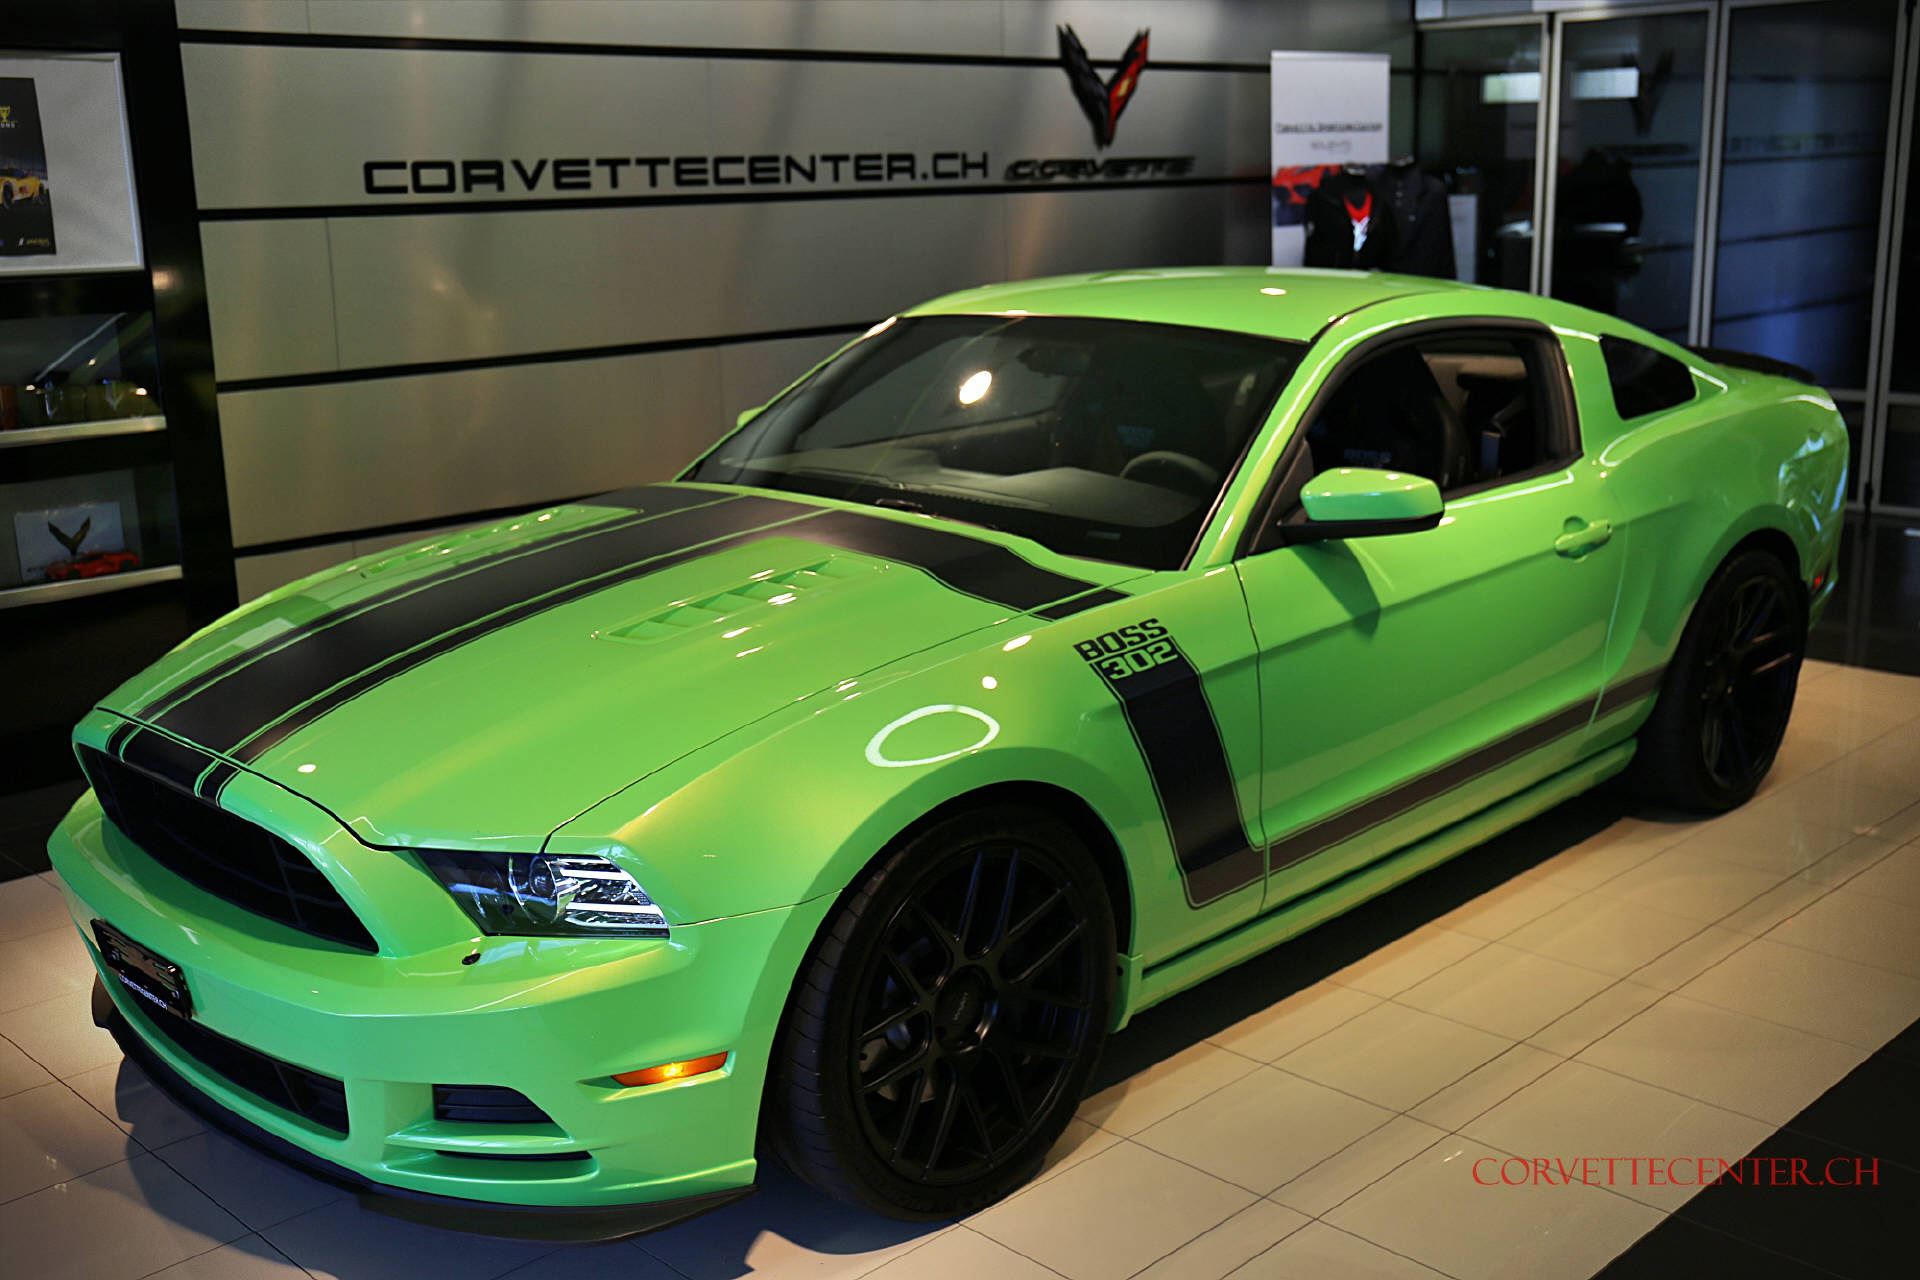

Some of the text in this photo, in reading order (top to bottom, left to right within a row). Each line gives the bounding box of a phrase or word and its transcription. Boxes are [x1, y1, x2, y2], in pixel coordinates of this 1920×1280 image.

[363, 152, 989, 195] CORVETTECENTER.CH
[1005, 156, 1196, 181] CORVETTE
[1073, 618, 1169, 662] BOSS
[1101, 640, 1178, 680] 302
